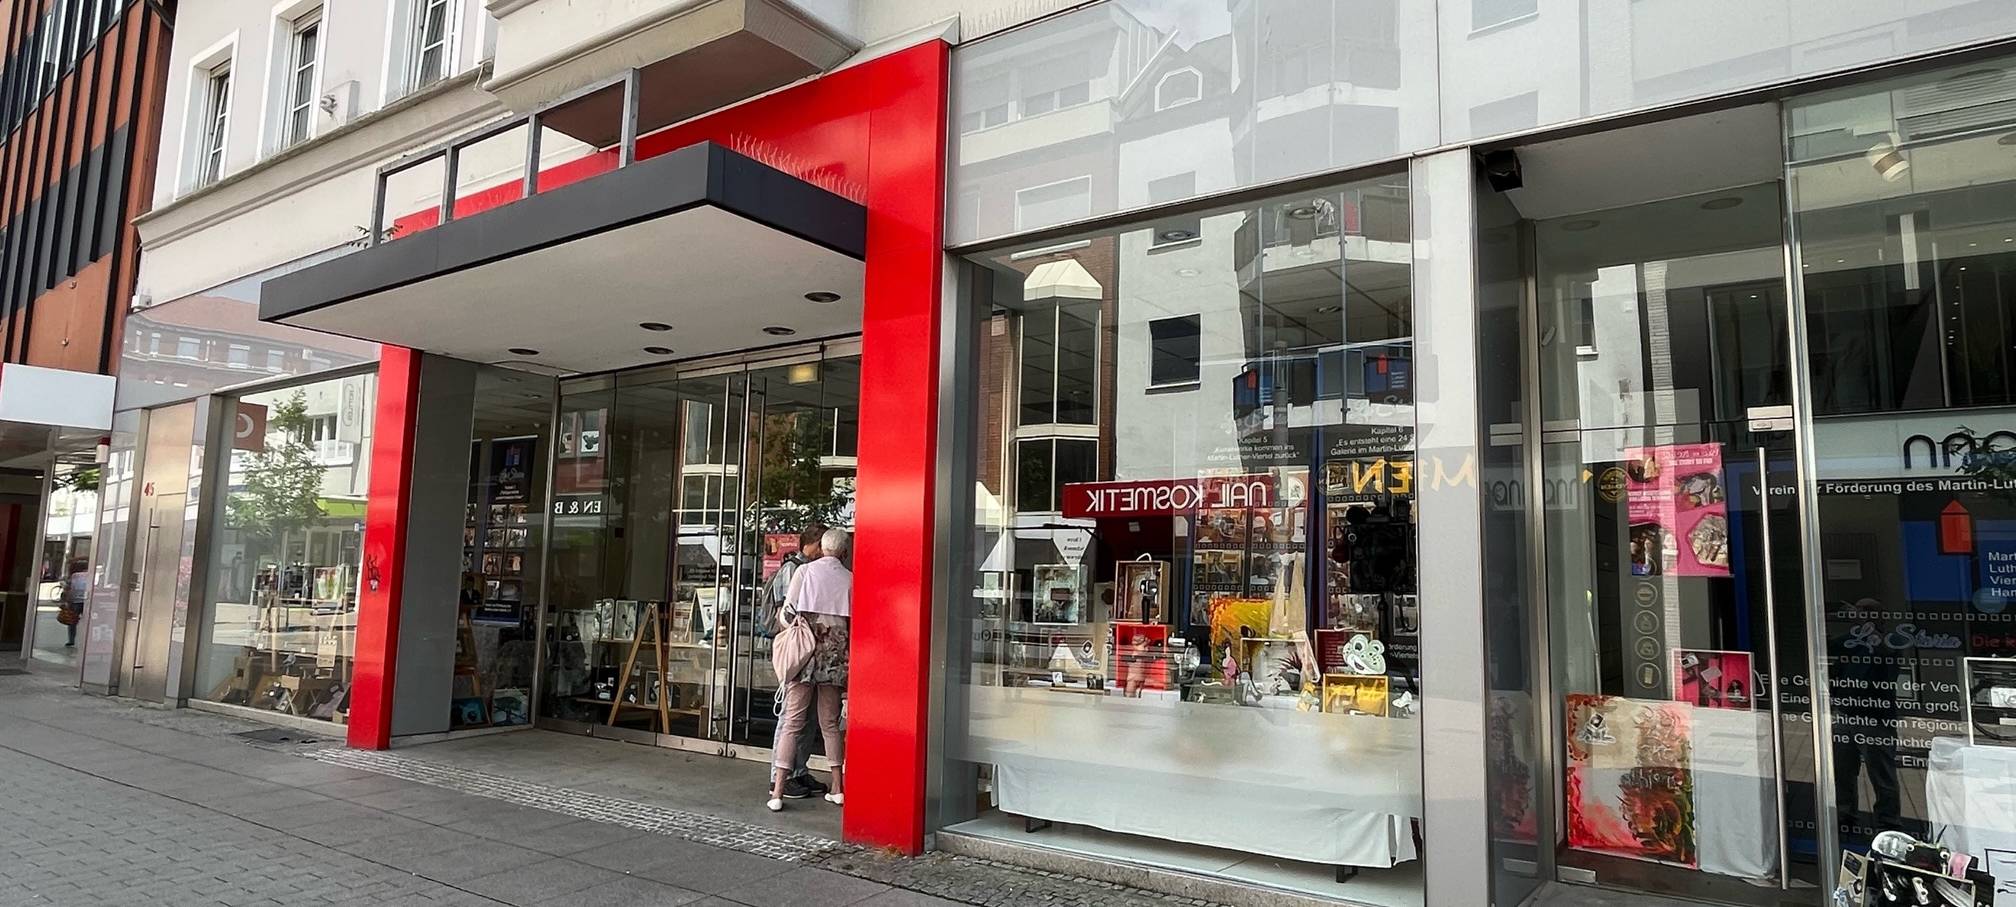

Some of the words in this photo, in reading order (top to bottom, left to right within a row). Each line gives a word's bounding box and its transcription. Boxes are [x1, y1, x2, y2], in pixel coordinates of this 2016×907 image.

[1752, 485, 1796, 496] Vrein
[1825, 482, 1902, 495] Förderung
[1906, 480, 1934, 492] des
[1872, 680, 1898, 690] von
[1902, 680, 1926, 692] der
[1780, 692, 1810, 705] Eine
[1894, 701, 1921, 711] von
[1882, 719, 1908, 729] von
[1854, 733, 1933, 749] Geschichte
